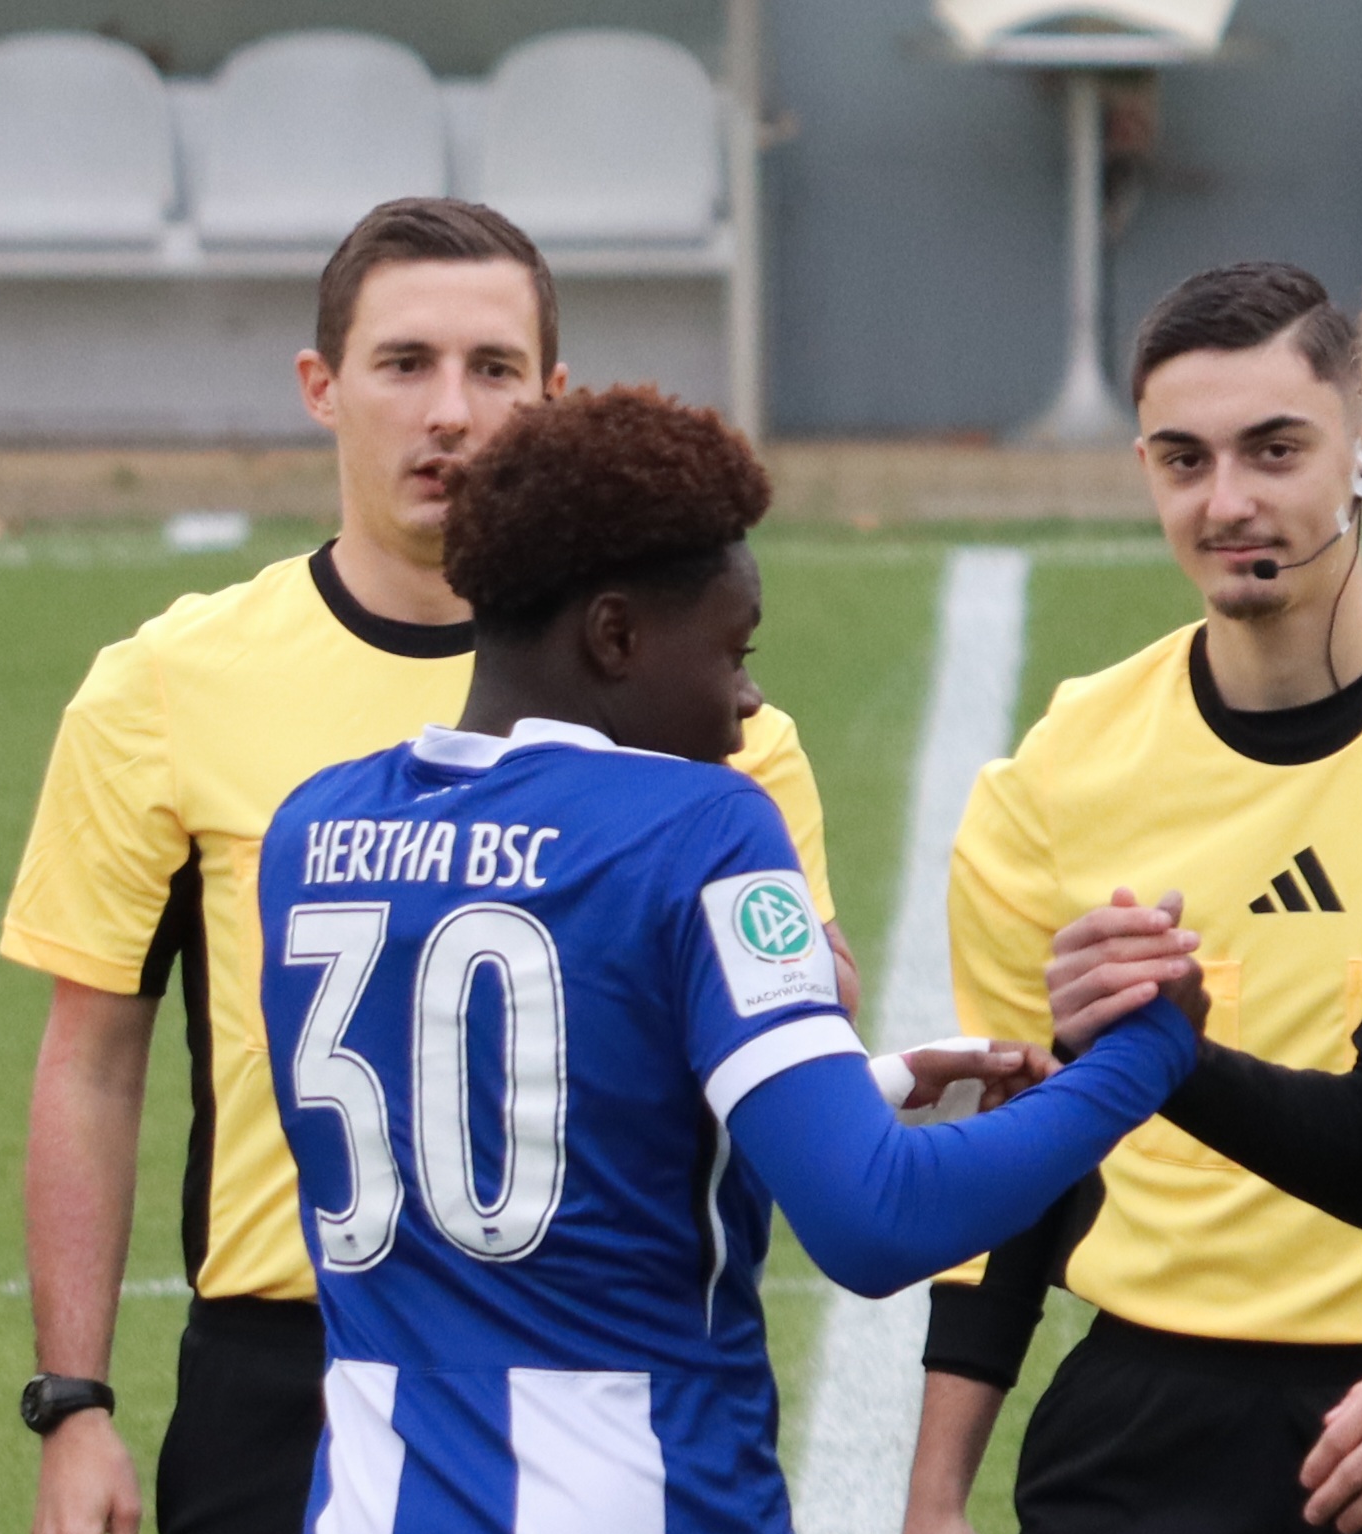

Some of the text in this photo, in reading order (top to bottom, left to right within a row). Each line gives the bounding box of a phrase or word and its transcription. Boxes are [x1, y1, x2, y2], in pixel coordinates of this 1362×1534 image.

[303, 819, 561, 888] HERTHA BSC
[284, 901, 567, 1273] 30
